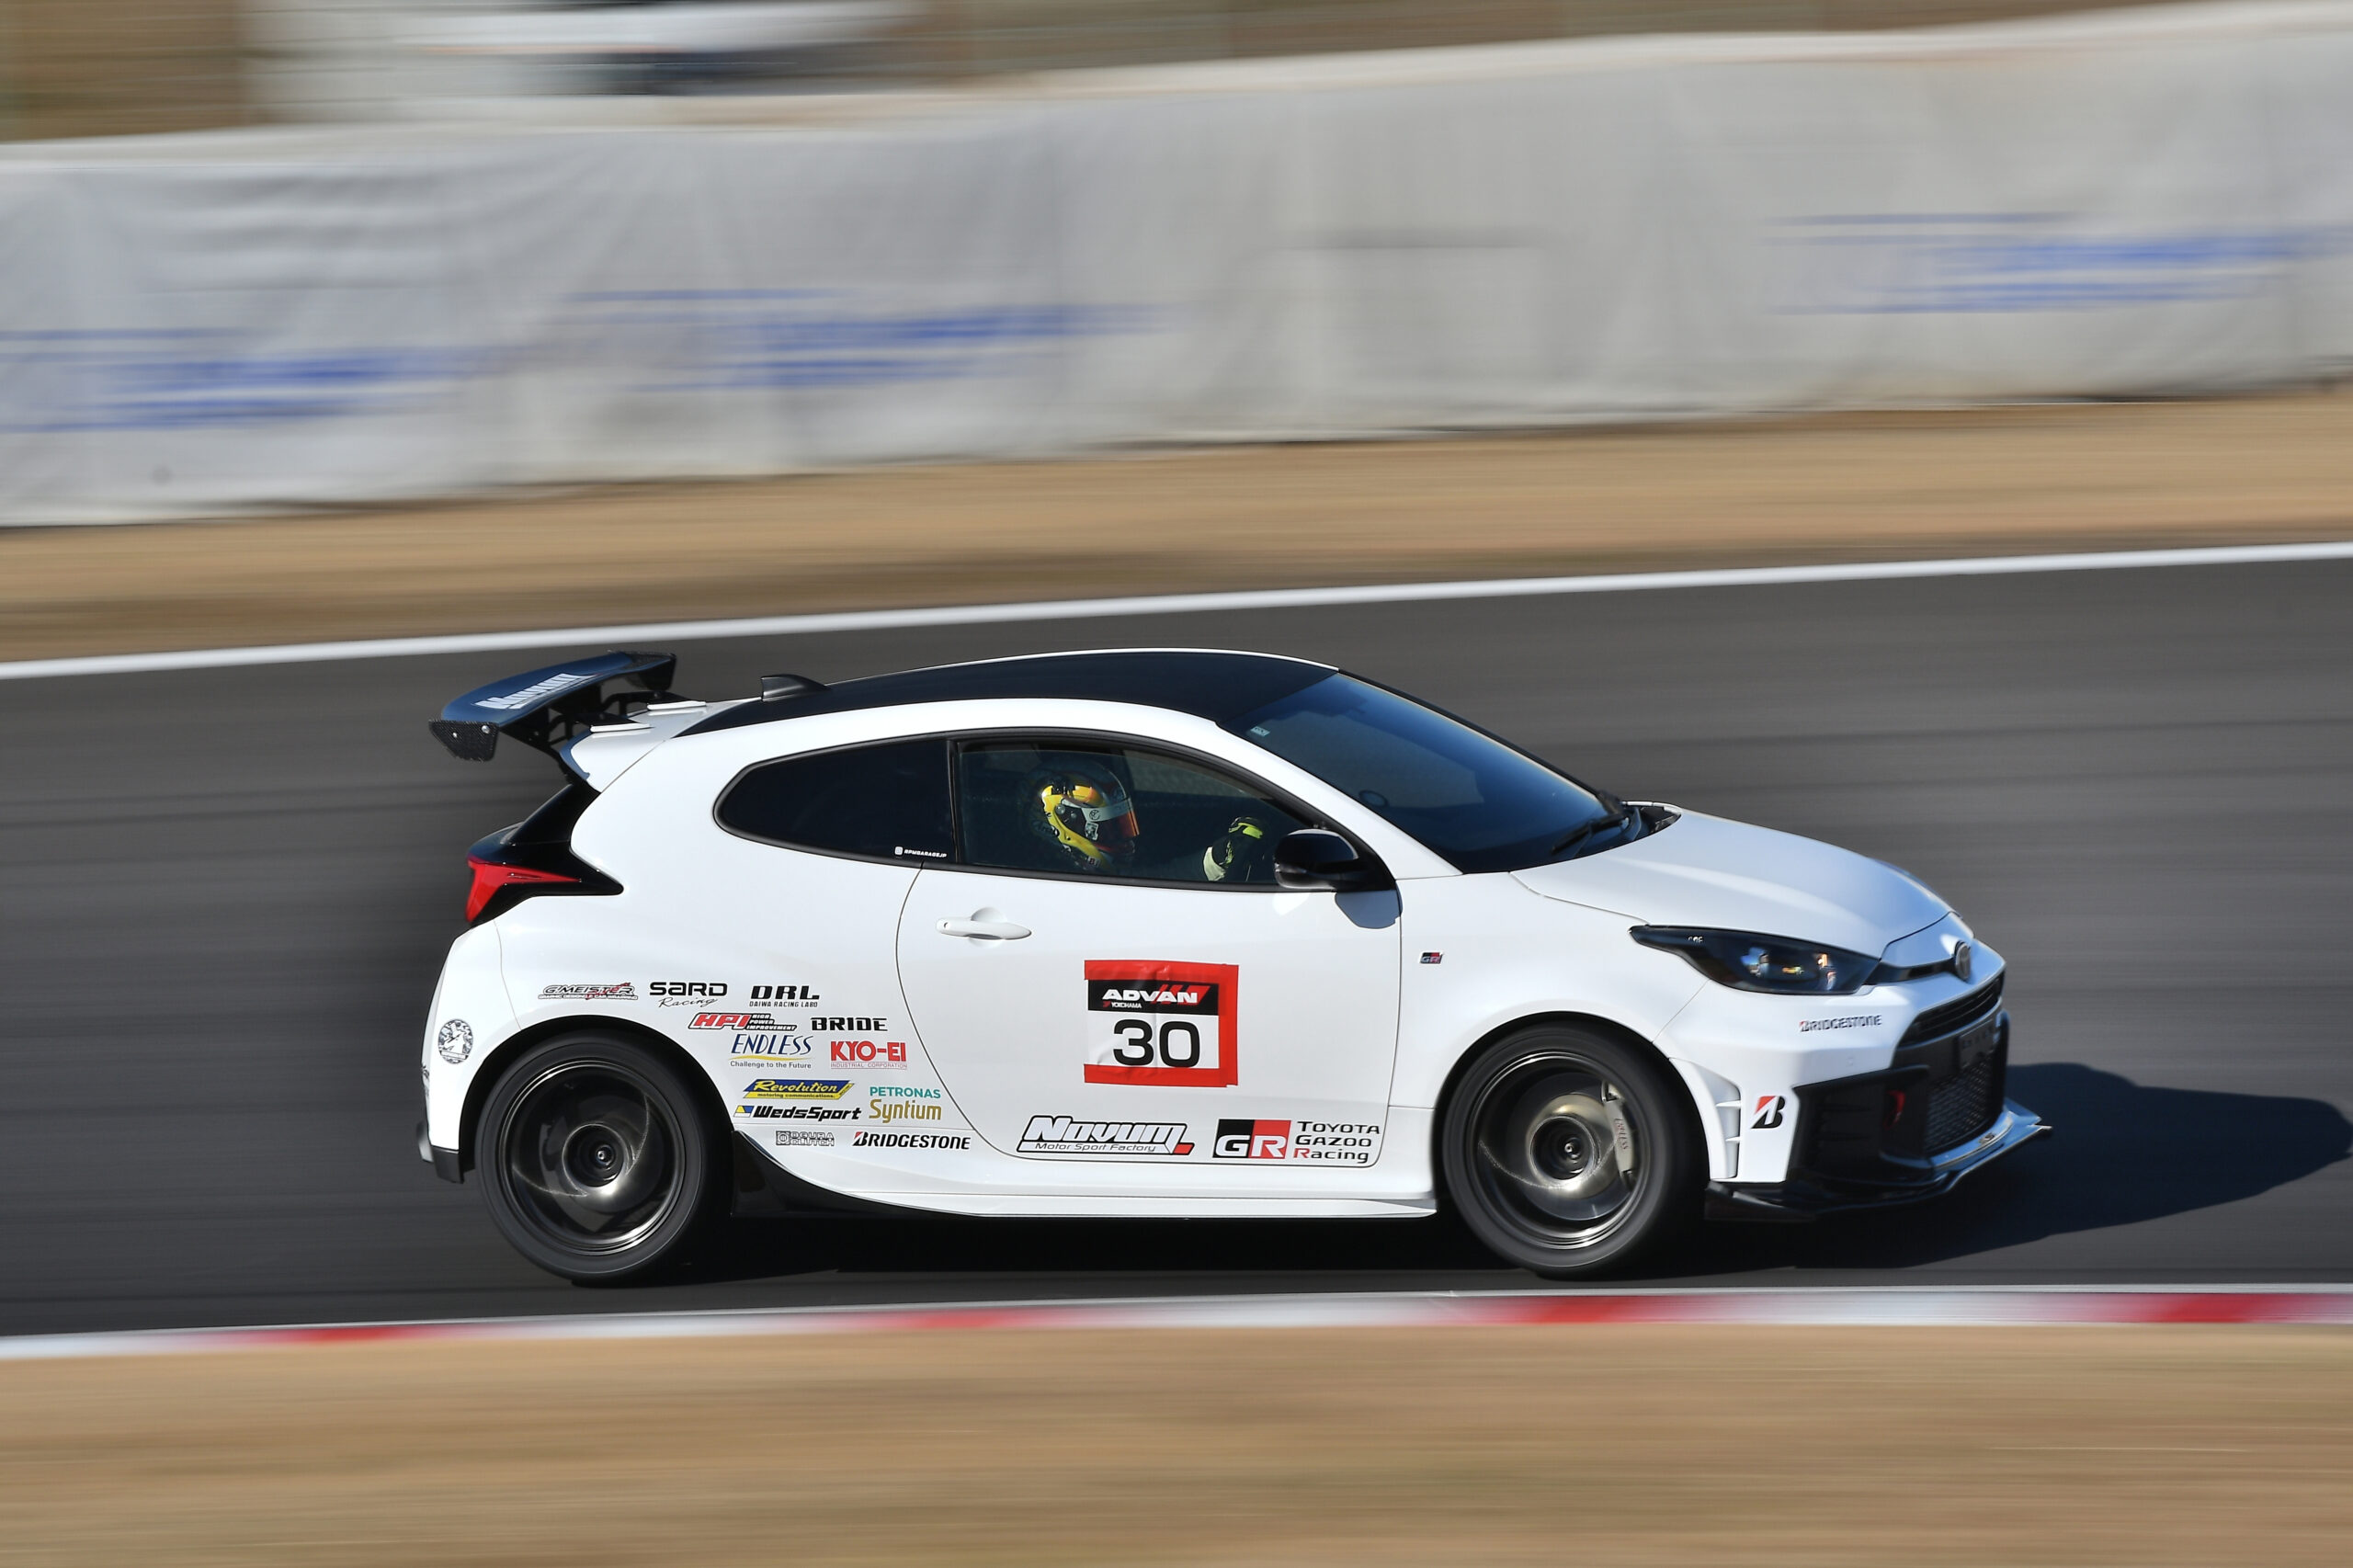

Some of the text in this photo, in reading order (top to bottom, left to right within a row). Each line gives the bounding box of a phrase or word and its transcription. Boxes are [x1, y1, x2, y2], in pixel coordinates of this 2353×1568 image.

[750, 985, 820, 1000] DRL
[1102, 989, 1198, 1004] ADVAN
[658, 996, 718, 1008] Racing
[692, 1013, 752, 1028] HPI
[811, 1017, 888, 1031] BRIDE
[1799, 1014, 1882, 1032] BRIDGESTONE
[731, 1034, 814, 1055] ENDLESS
[1113, 1018, 1200, 1068] 30
[830, 1040, 906, 1062] KYO-EI
[730, 1061, 765, 1069] Challenge
[753, 1080, 837, 1093] Revolution
[870, 1086, 941, 1098] PETRONAS
[753, 1106, 862, 1122] WedsSport
[869, 1098, 942, 1123] Syntium
[1297, 1120, 1381, 1135] TOYOTA
[852, 1131, 972, 1150] BRIDGESTONE
[1035, 1142, 1156, 1153] Motor Sport Factory
[1215, 1134, 1287, 1158] GR
[1295, 1135, 1372, 1148] GAZOO
[1292, 1148, 1370, 1165] Racing
